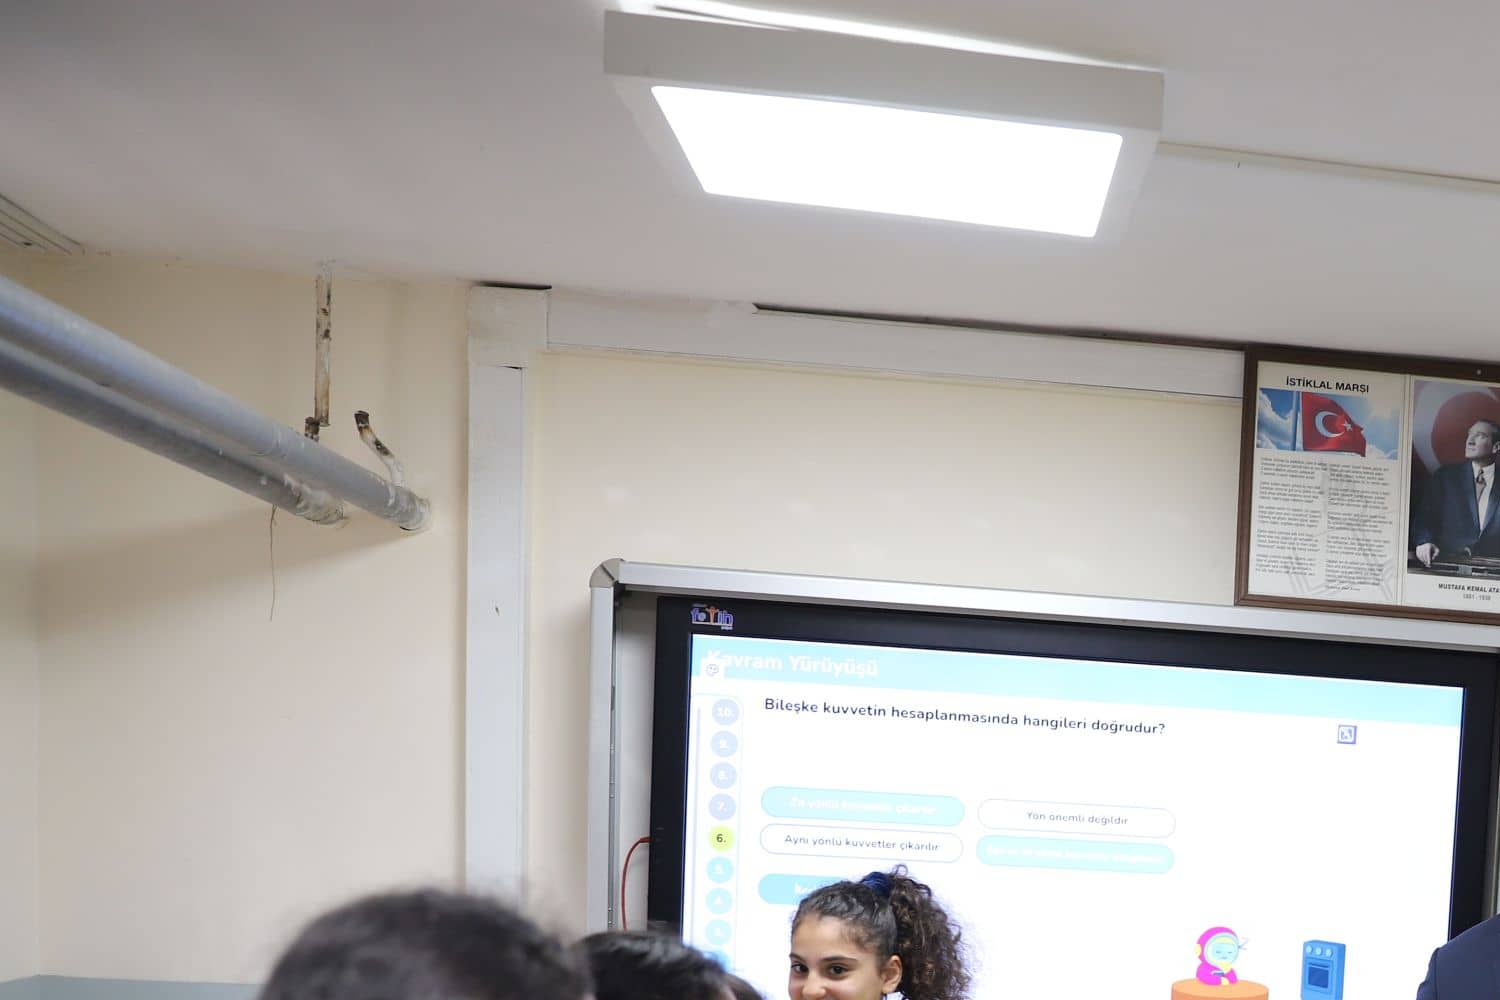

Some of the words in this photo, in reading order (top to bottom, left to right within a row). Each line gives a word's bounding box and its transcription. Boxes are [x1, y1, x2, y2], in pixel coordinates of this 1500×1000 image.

[1286, 375, 1333, 390] İSTİKLAL
[1438, 583, 1465, 591] MUSTAFA
[1467, 585, 1488, 593] KEMAL
[765, 698, 818, 714] Bileşke
[823, 702, 886, 717] kuvvetin
[891, 706, 1018, 725] hesaplanmasında
[1023, 715, 1087, 731] hangileri
[1091, 719, 1166, 735] doğrudur?
[716, 833, 727, 843] 6.
